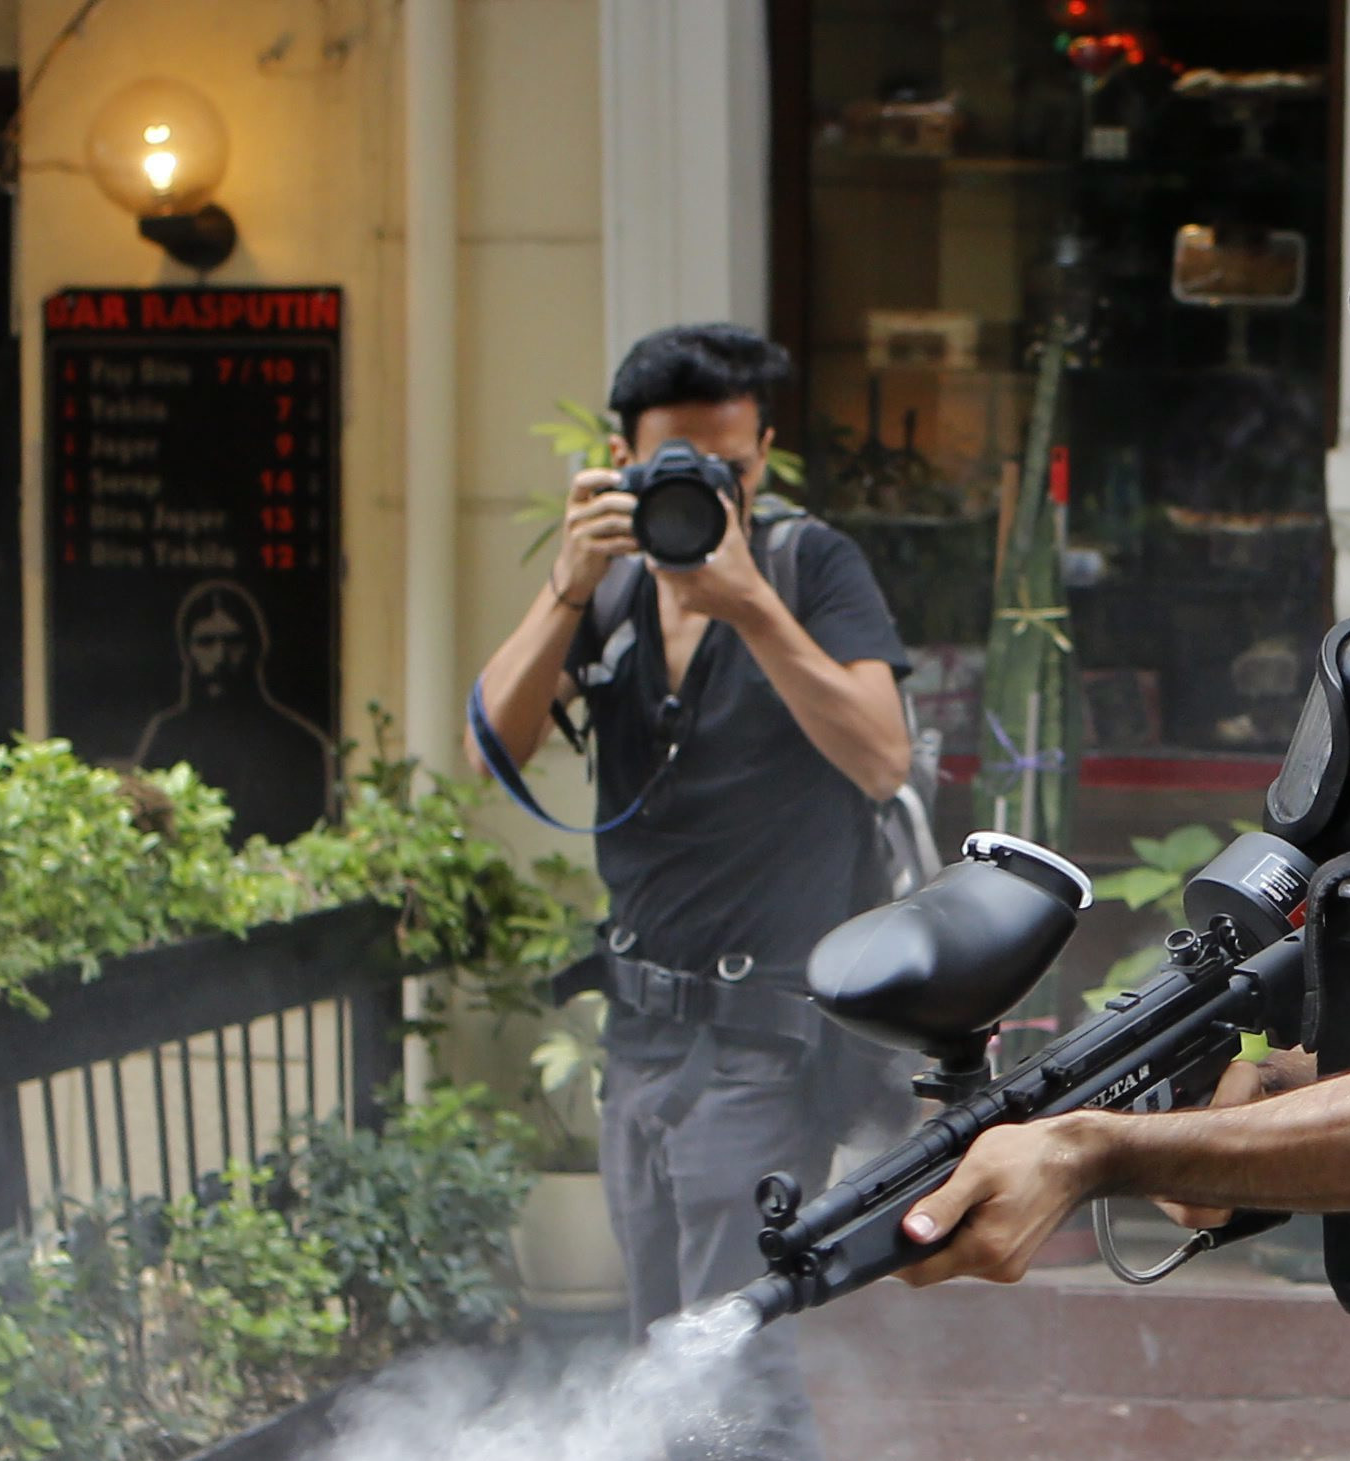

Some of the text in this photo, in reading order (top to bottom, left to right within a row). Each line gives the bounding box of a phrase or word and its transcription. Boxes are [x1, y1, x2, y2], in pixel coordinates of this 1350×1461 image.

[141, 293, 338, 328] RASPUTIN
[260, 357, 295, 384] 10
[277, 396, 292, 421] 7
[276, 433, 293, 457] 9
[260, 469, 294, 495] 14
[260, 506, 294, 532] 13
[260, 544, 295, 569] 12
